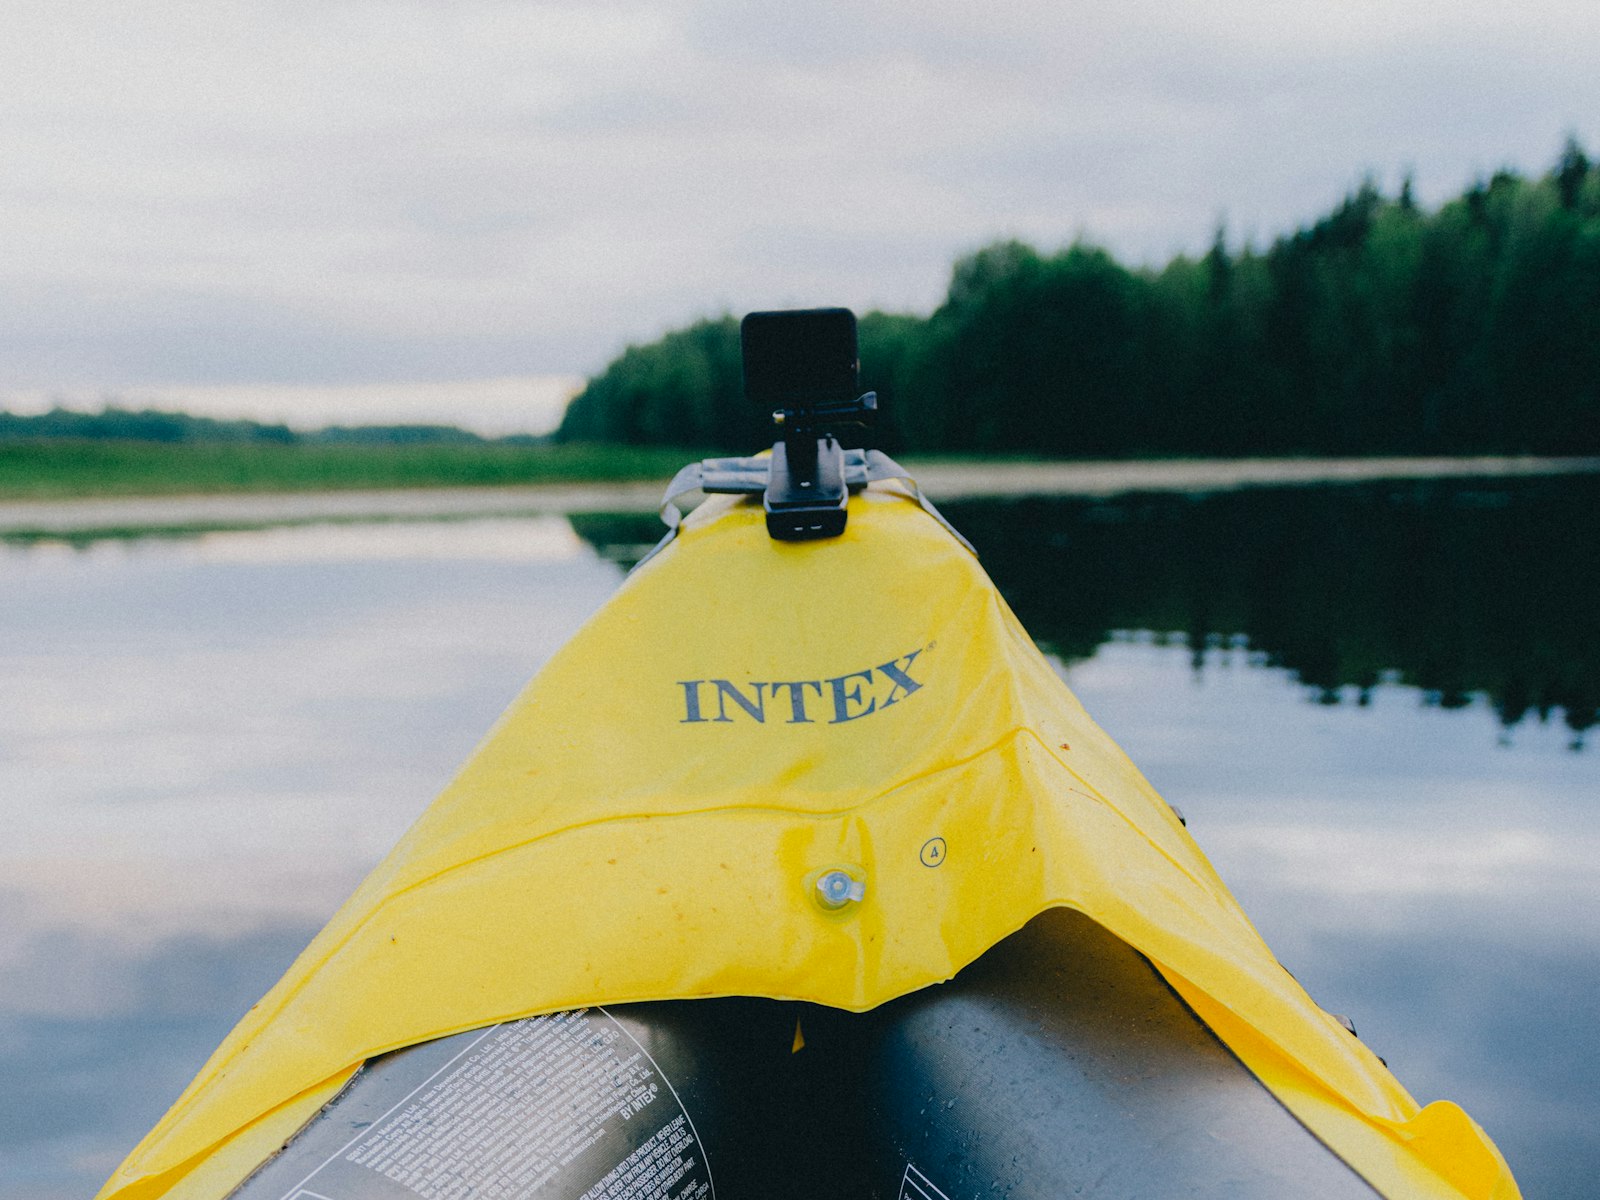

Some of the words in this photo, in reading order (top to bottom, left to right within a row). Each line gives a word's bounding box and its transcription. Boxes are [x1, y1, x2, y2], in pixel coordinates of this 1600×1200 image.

[930, 846, 939, 859] 4
[433, 1059, 472, 1093] Development
[587, 1179, 606, 1200] ALLOW
[615, 1159, 630, 1176] INTO
[625, 1151, 639, 1168] THIS
[635, 1135, 659, 1159] PRODUCT.
[656, 1123, 672, 1142] NEVER
[668, 1112, 686, 1132] LEAVE
[607, 1178, 625, 1198] NEVER
[621, 1170, 634, 1185] TOW
[631, 1160, 646, 1177] FROM
[642, 1152, 655, 1167] ANY
[668, 1125, 687, 1146] ADULTS
[652, 1174, 661, 1186] AS
[658, 1154, 683, 1181] NAVIGATION
[620, 1184, 635, 1200] EACH
[656, 1157, 665, 1170] DO
[662, 1150, 673, 1164] NOT
[651, 1186, 663, 1200] ANY
[660, 1174, 676, 1193] OTHER
[672, 1165, 685, 1181] BODY
